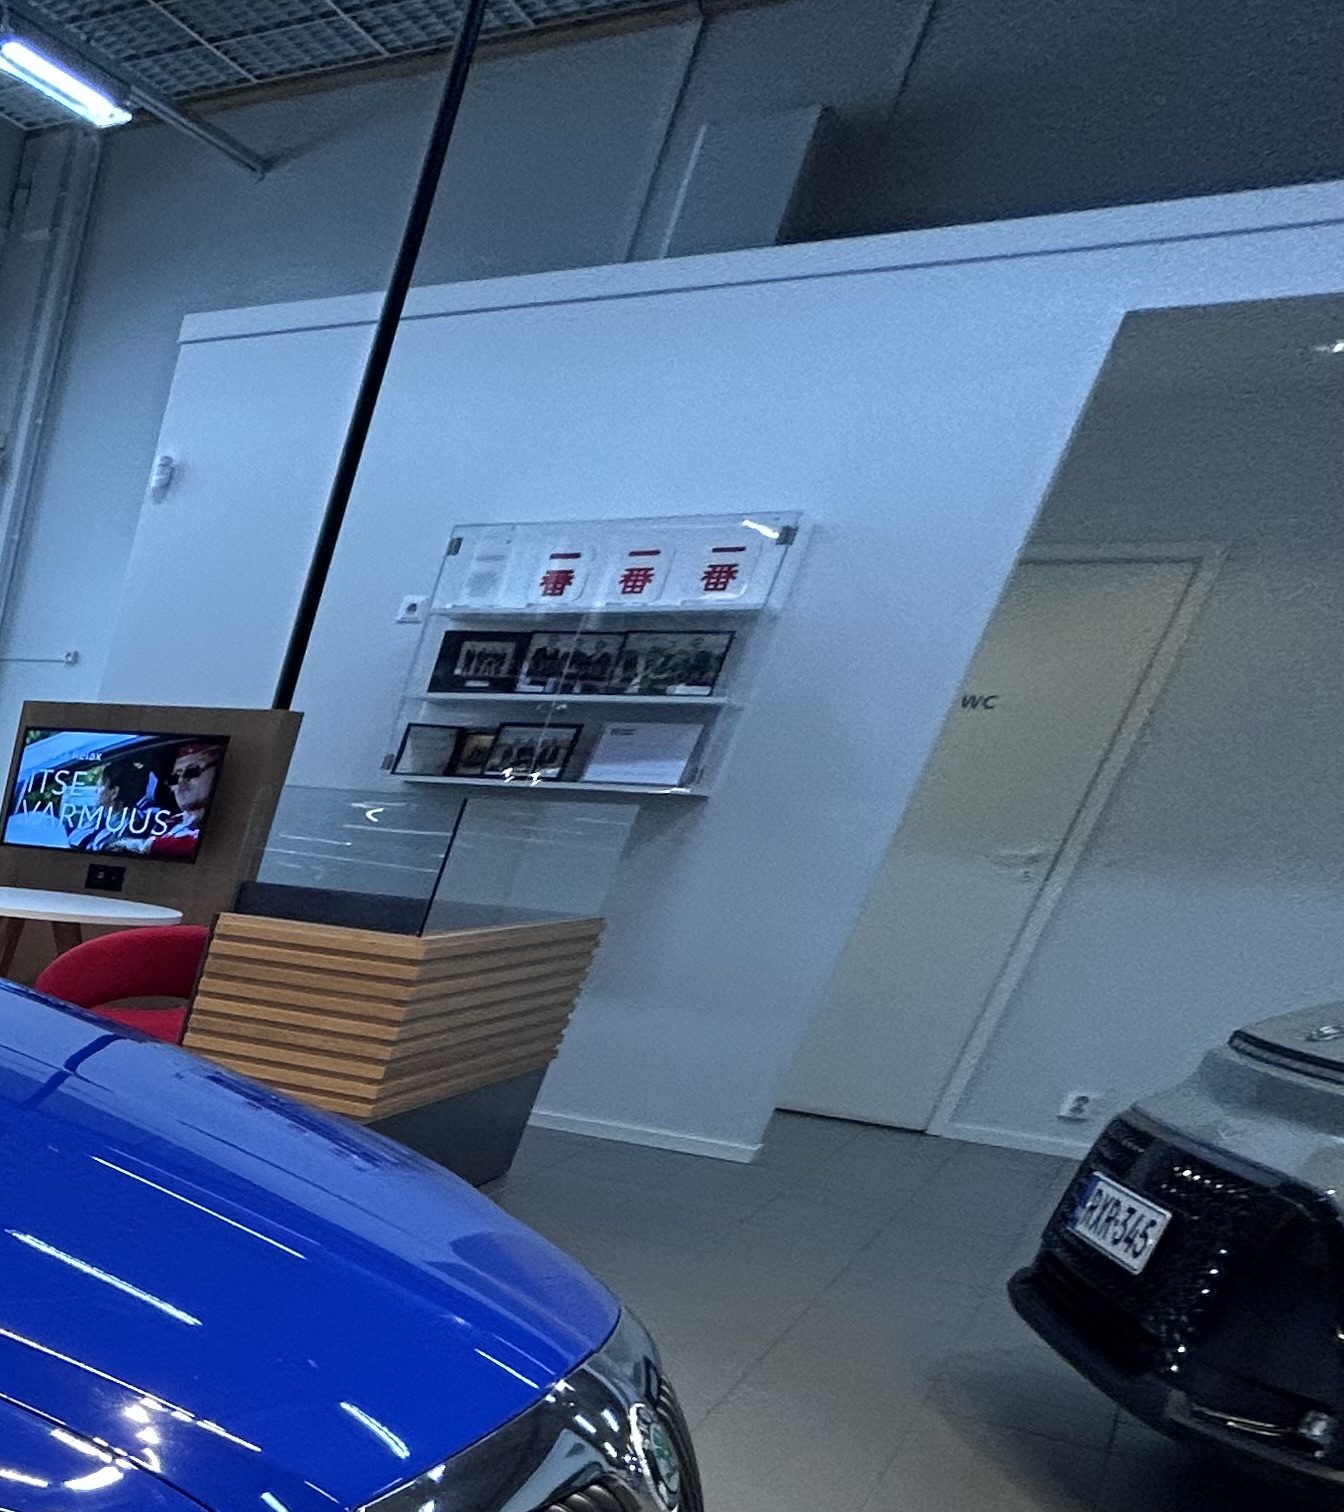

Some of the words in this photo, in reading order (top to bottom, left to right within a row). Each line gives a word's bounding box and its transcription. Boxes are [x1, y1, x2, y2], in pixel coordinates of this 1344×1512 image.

[961, 694, 999, 710] WC
[27, 769, 88, 796] ITSE
[21, 799, 171, 836] VARMUUS
